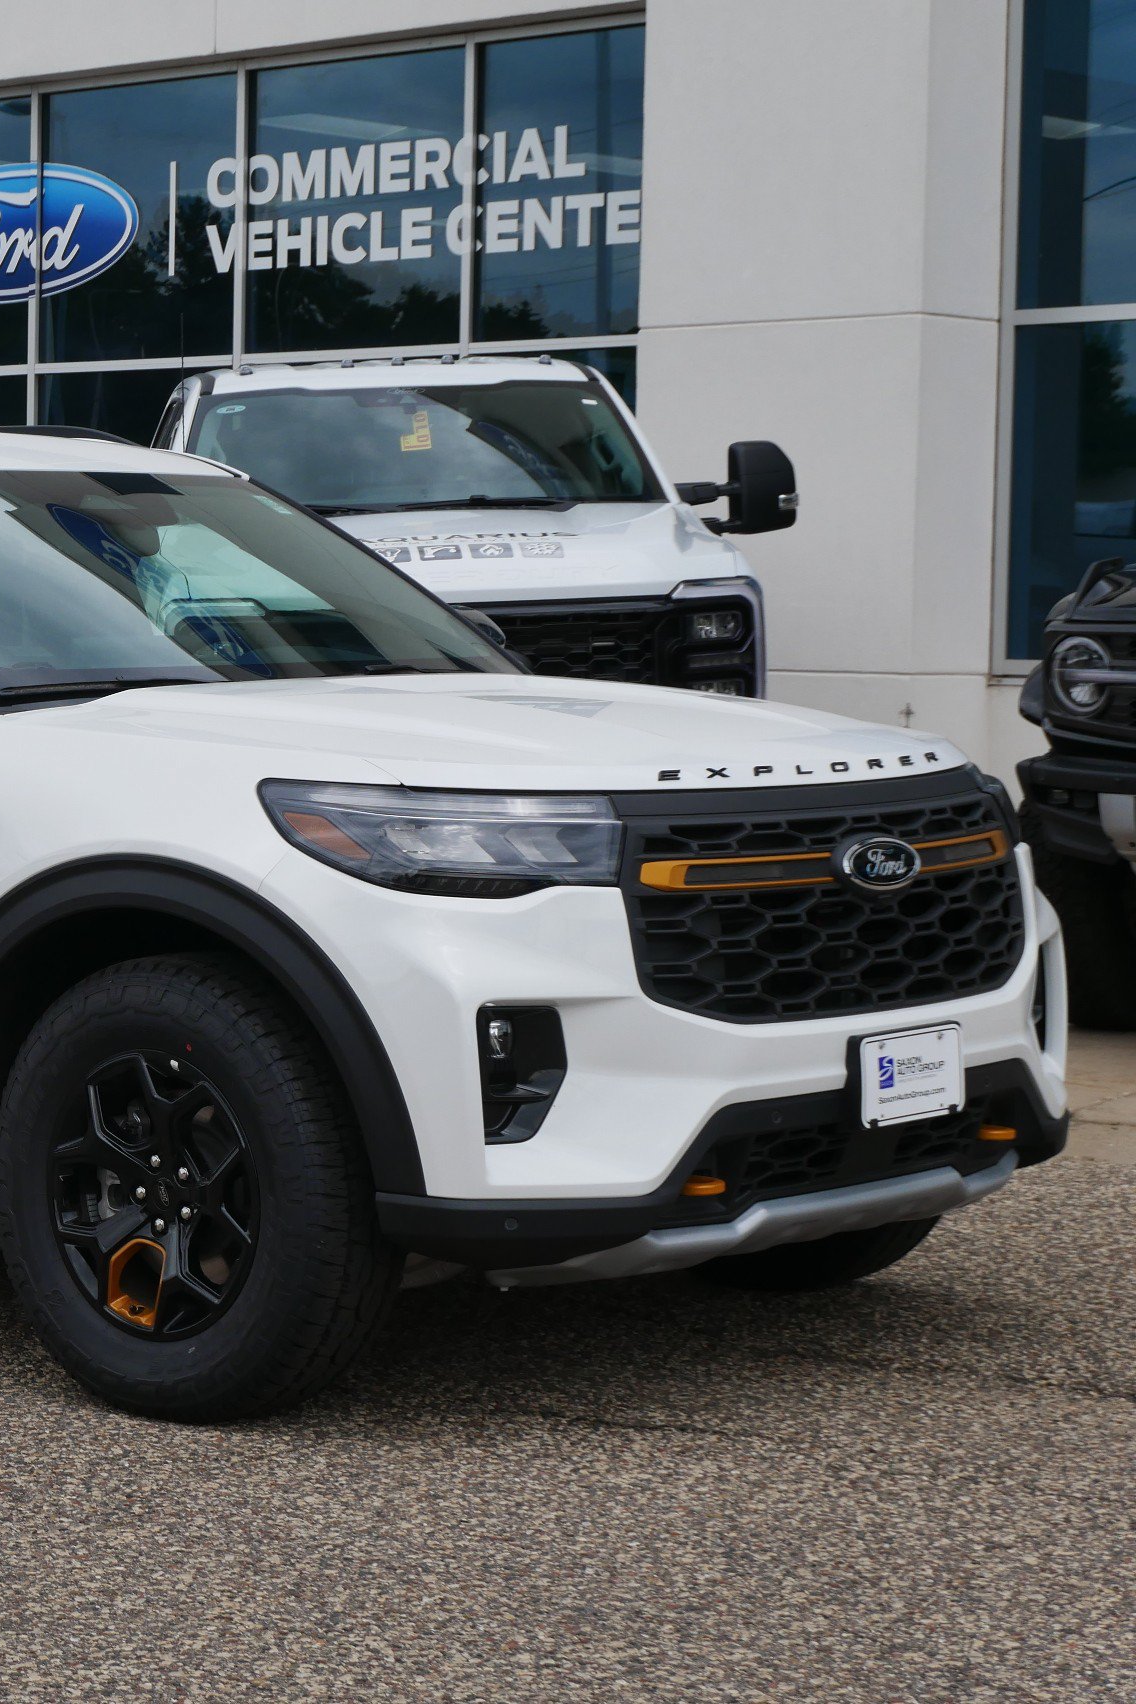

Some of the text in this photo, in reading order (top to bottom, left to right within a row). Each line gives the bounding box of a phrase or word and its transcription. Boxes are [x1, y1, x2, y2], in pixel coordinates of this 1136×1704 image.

[207, 125, 586, 208] COMMERCIAL
[206, 207, 432, 273] VEHICLE
[657, 751, 939, 782] EXPLORER
[865, 848, 908, 877] Ford
[918, 1060, 945, 1073] GROUP
